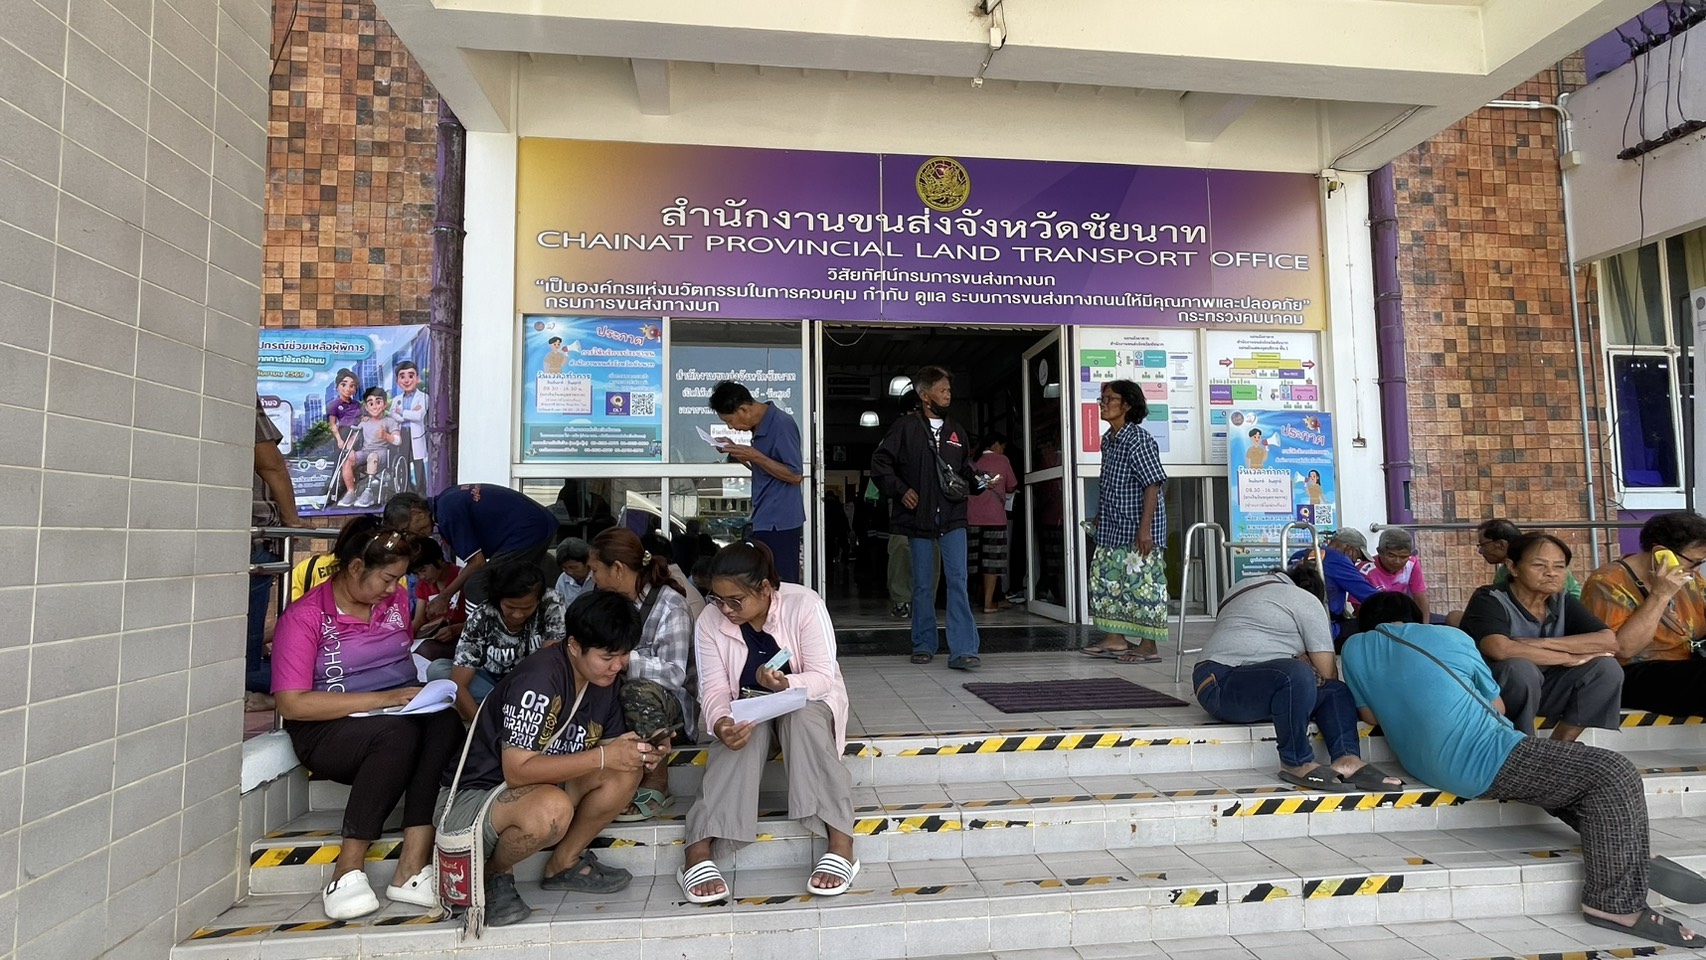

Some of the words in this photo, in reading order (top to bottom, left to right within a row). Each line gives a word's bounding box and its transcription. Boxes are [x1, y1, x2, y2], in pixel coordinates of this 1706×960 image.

[660, 197, 1207, 244] สำนักงานขนส่งจังหวัดชัยนาท
[537, 231, 693, 252] CHAINAT
[706, 235, 904, 258] PROVINCIAL
[916, 242, 1001, 262] LAND
[1011, 246, 1199, 267] TRANSPORT
[1209, 250, 1310, 271] OFFICE
[827, 267, 1056, 287] วิสัยทัศน์กรมการขนส่งทางบก
[544, 295, 720, 312] กรมการขนส่งทางบก
[863, 284, 910, 302] กำกับ
[914, 289, 946, 307] ดูแล
[1177, 310, 1304, 325] กระทรวงคมนาคม
[596, 325, 646, 347] ประกาศ
[1280, 424, 1326, 446] ประกาศ
[1238, 465, 1290, 476] วันเวลาทำการ
[520, 690, 550, 714] OR
[502, 703, 543, 725] AILAND
[503, 717, 540, 737] GRAND
[566, 723, 587, 743] OR
[509, 731, 536, 748] PRIX
